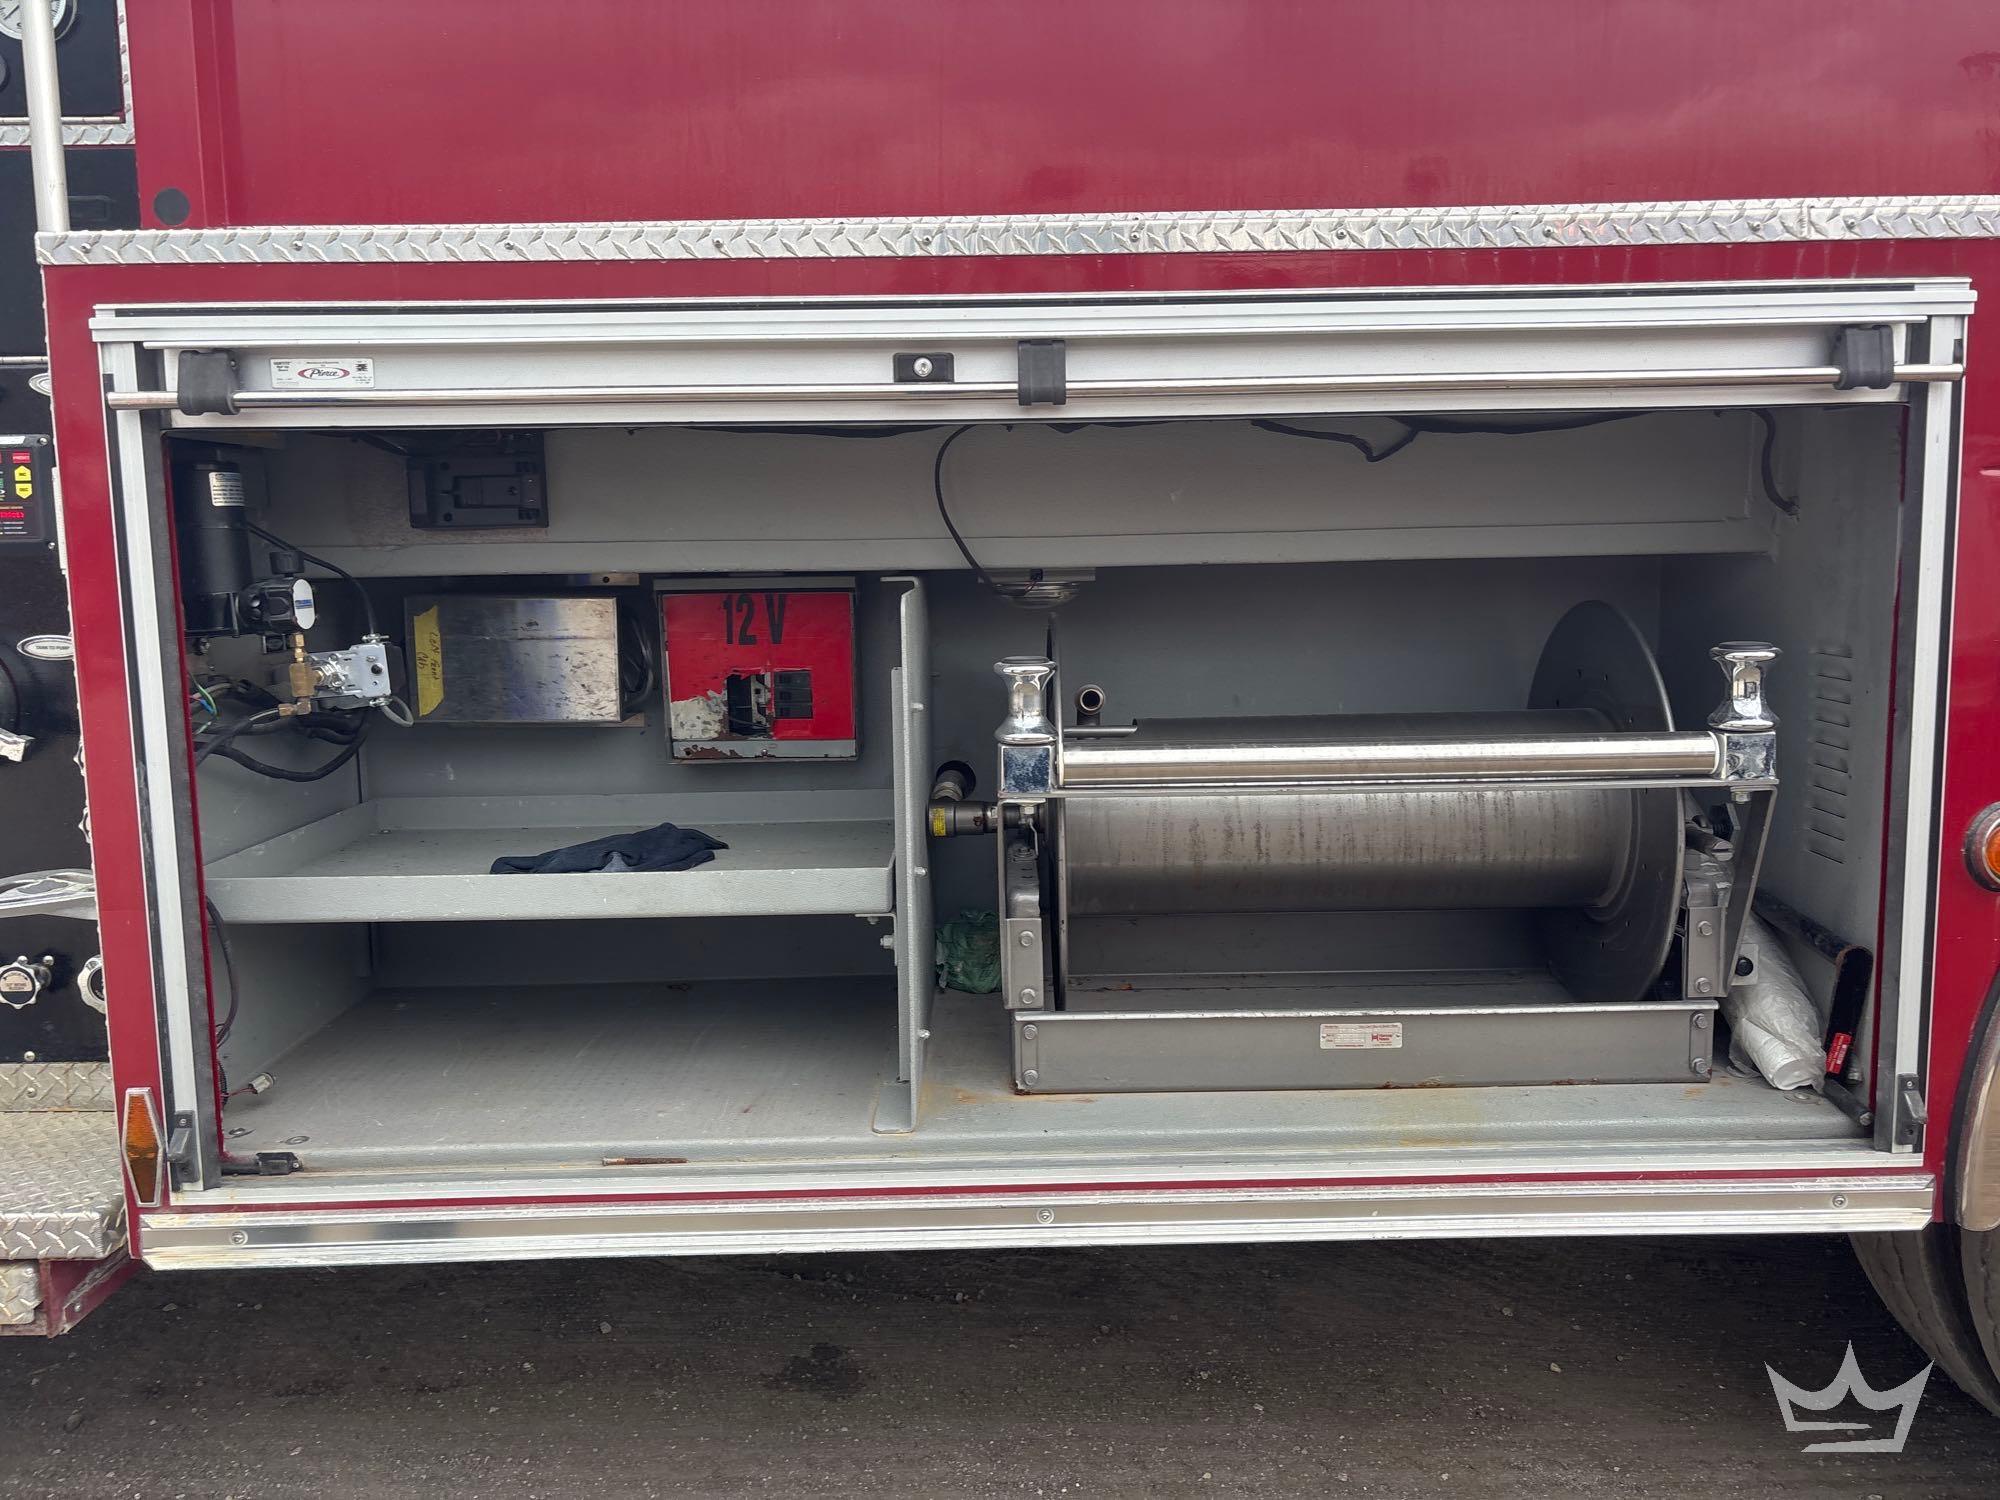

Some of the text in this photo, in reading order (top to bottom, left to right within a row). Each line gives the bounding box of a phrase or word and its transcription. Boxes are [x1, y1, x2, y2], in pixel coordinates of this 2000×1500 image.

[309, 368, 339, 378] Pierce
[722, 592, 785, 645] 12 V
